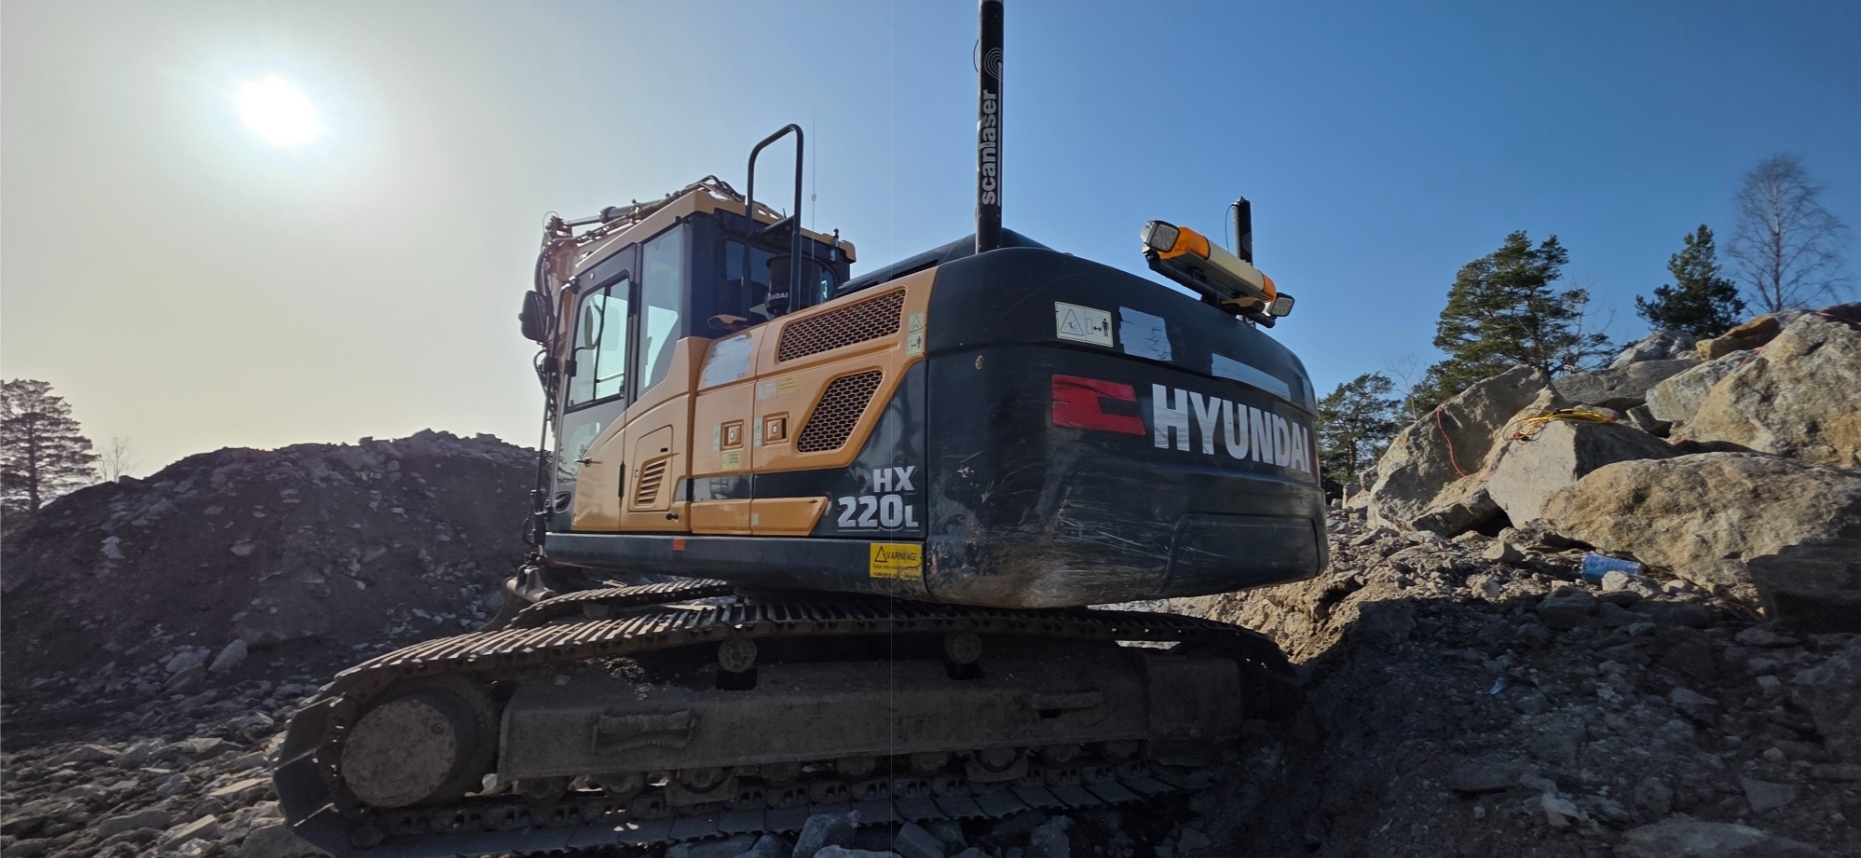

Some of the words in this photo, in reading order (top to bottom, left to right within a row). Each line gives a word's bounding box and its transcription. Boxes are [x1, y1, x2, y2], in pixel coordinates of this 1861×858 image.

[979, 89, 997, 205] scanlaser
[1152, 383, 1310, 474] HYUNDAI
[873, 465, 916, 493] HX
[837, 494, 919, 528] 220L
